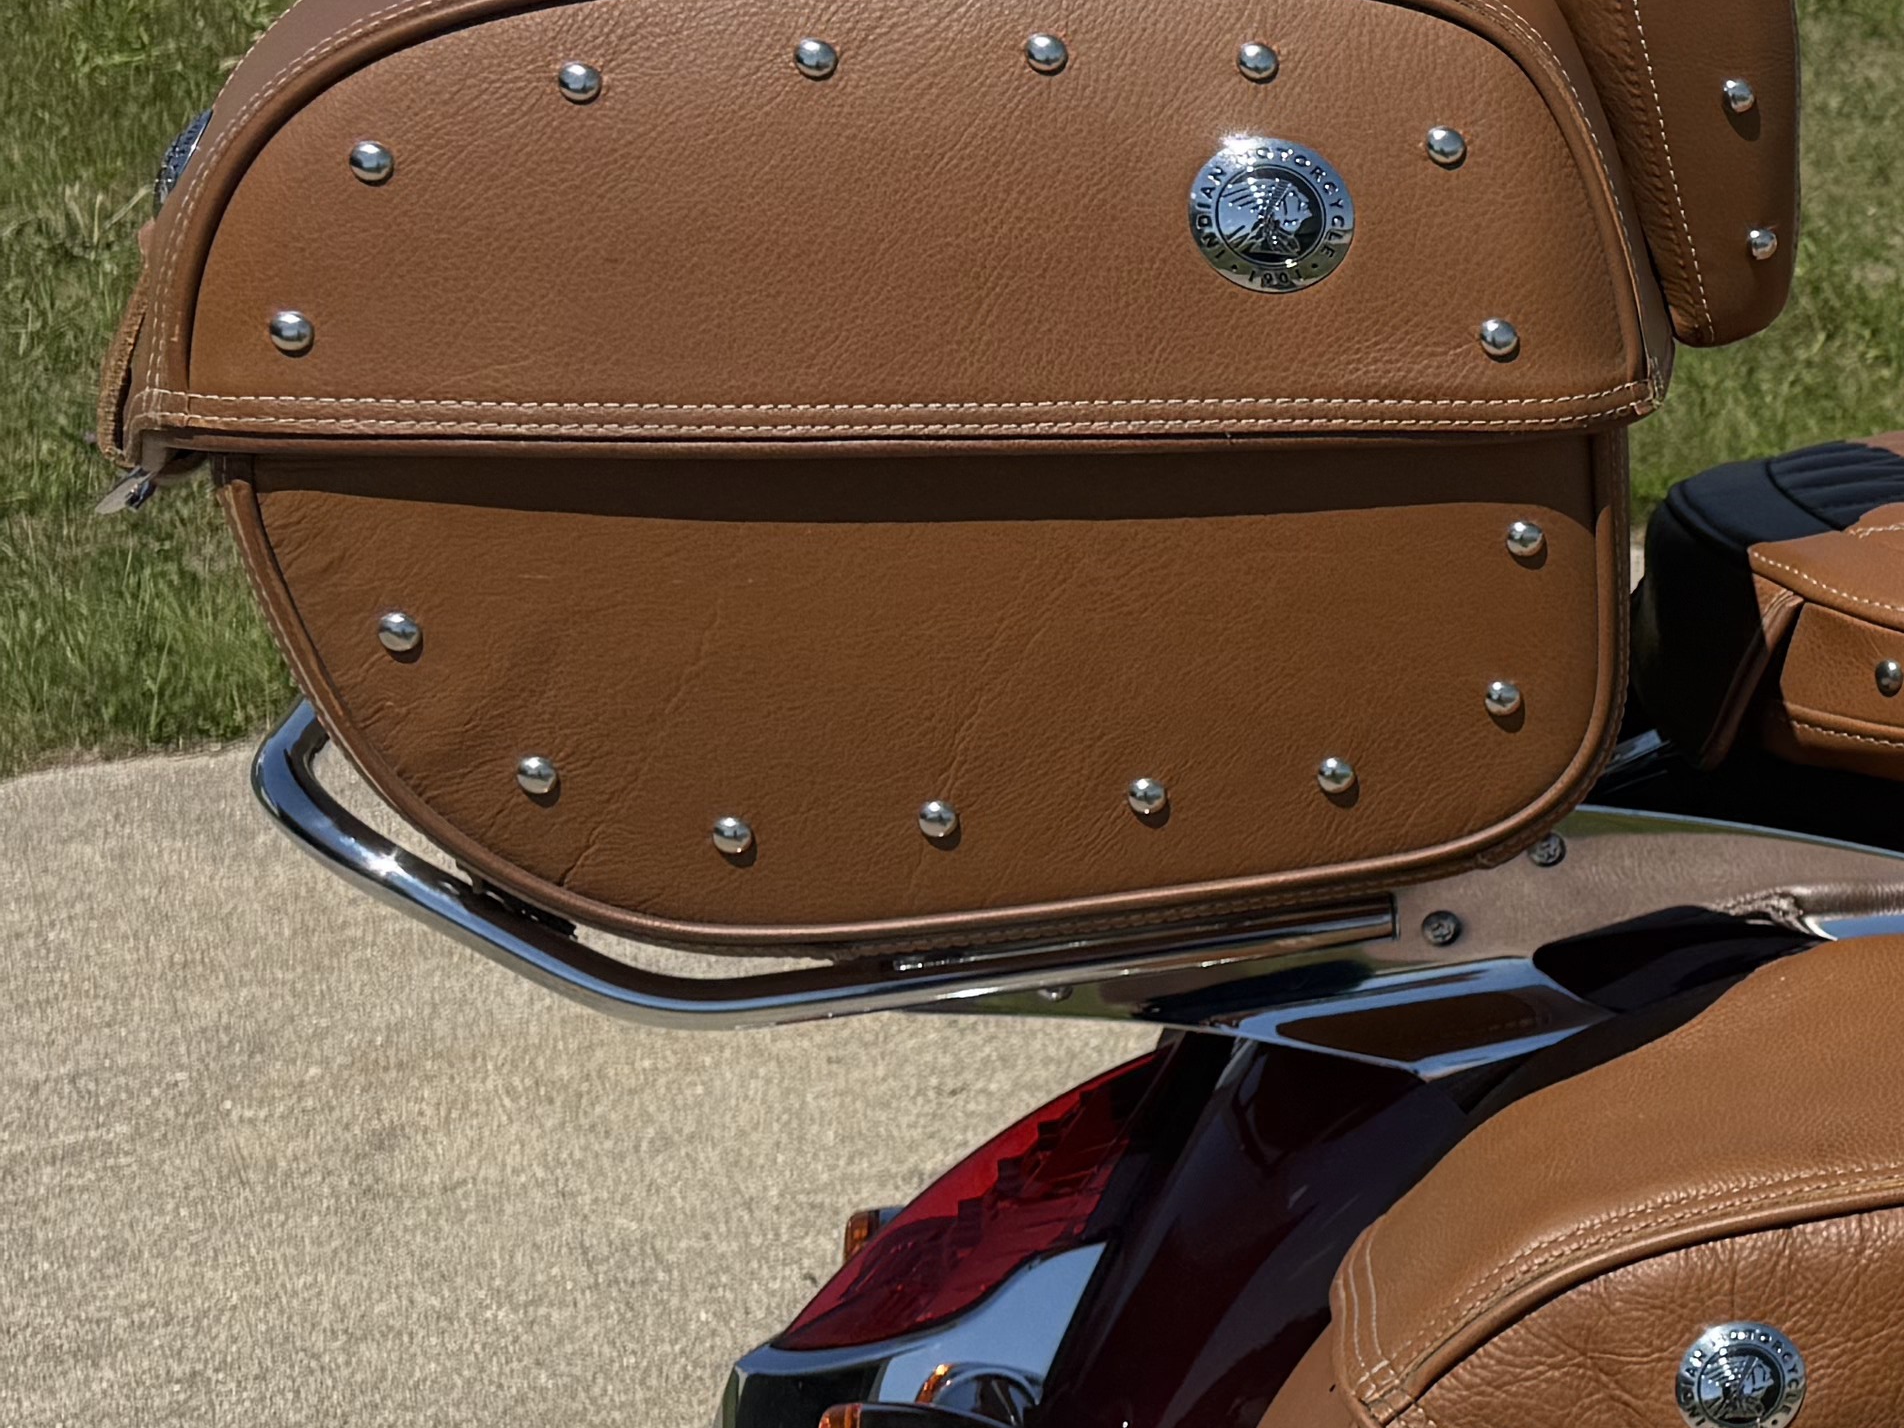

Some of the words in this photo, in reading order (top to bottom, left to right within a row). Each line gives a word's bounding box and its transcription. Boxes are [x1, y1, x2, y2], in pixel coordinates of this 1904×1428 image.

[1195, 165, 1227, 260] INDIAN
[1234, 146, 1346, 259] OTORCYCLE
[1247, 270, 1304, 288] 1901
